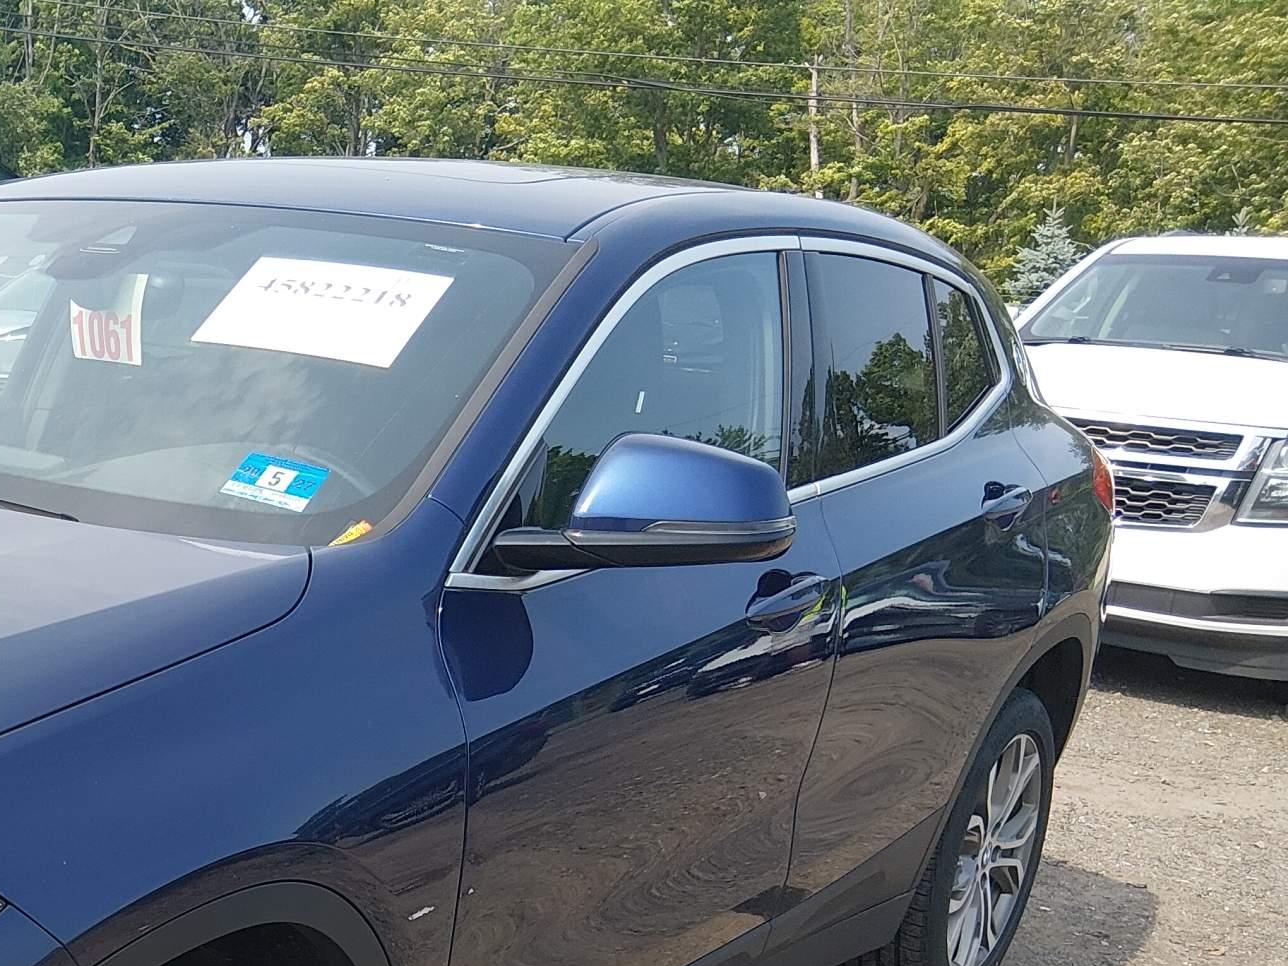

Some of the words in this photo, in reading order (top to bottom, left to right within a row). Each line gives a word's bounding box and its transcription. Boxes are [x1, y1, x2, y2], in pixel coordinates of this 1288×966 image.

[255, 277, 413, 308] 45822218
[72, 309, 134, 362] 1061
[268, 471, 286, 487] 5
